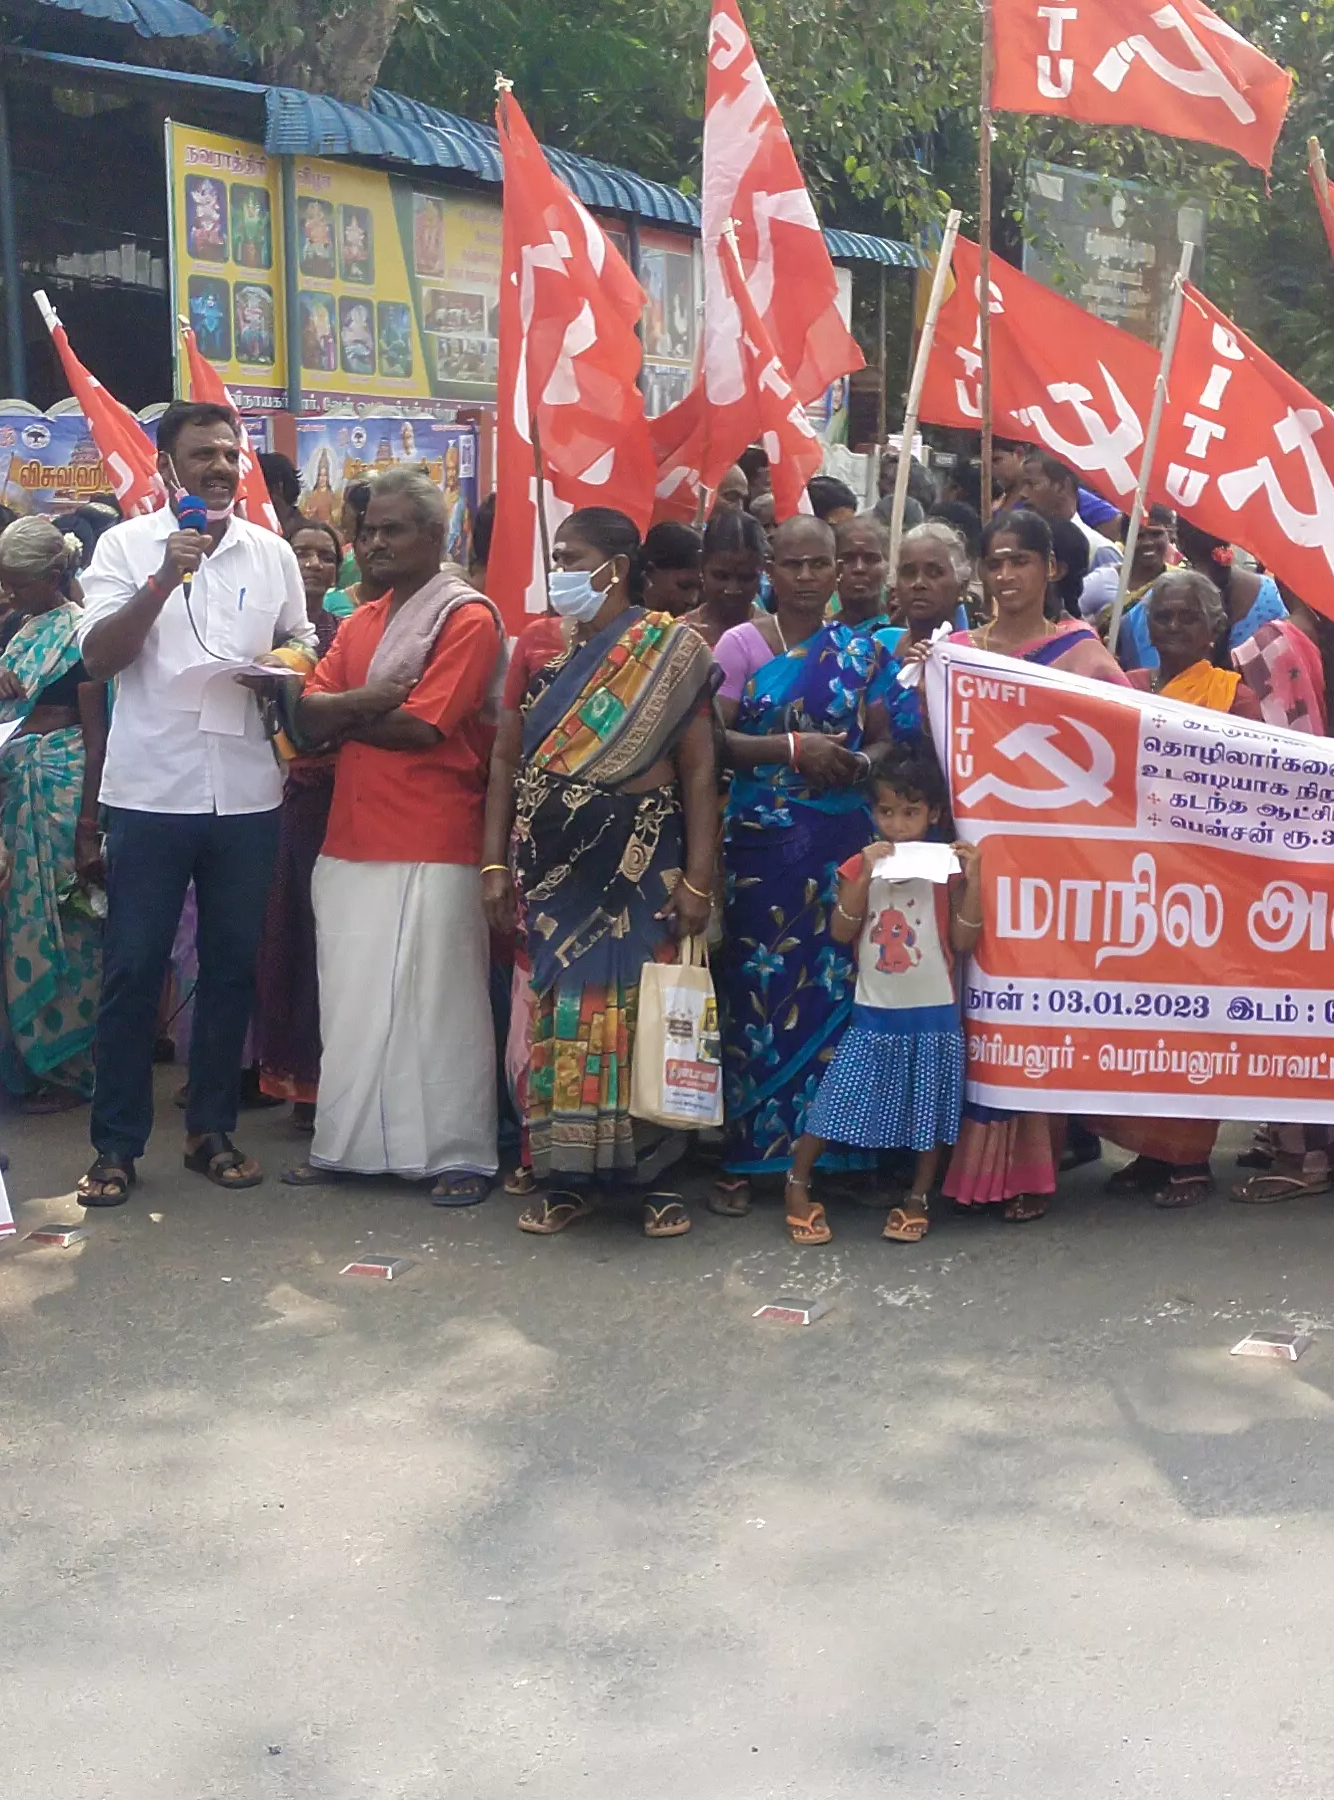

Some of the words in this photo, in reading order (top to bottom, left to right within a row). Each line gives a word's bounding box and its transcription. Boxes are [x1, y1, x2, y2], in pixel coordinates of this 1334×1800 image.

[957, 675, 1026, 706] CWFI
[1141, 764, 1290, 797] உடனடியாக
[1169, 790, 1248, 816] கடந்த
[1170, 815, 1274, 845] பென்சன்
[995, 852, 1224, 969] மாநில
[967, 983, 1024, 1011] நாள்
[1048, 989, 1210, 1020] 03.01.2023
[1226, 994, 1299, 1024] இடம்
[967, 1033, 1075, 1078] அரியலூர்
[1098, 1039, 1241, 1084] பெரம்பலூர்
